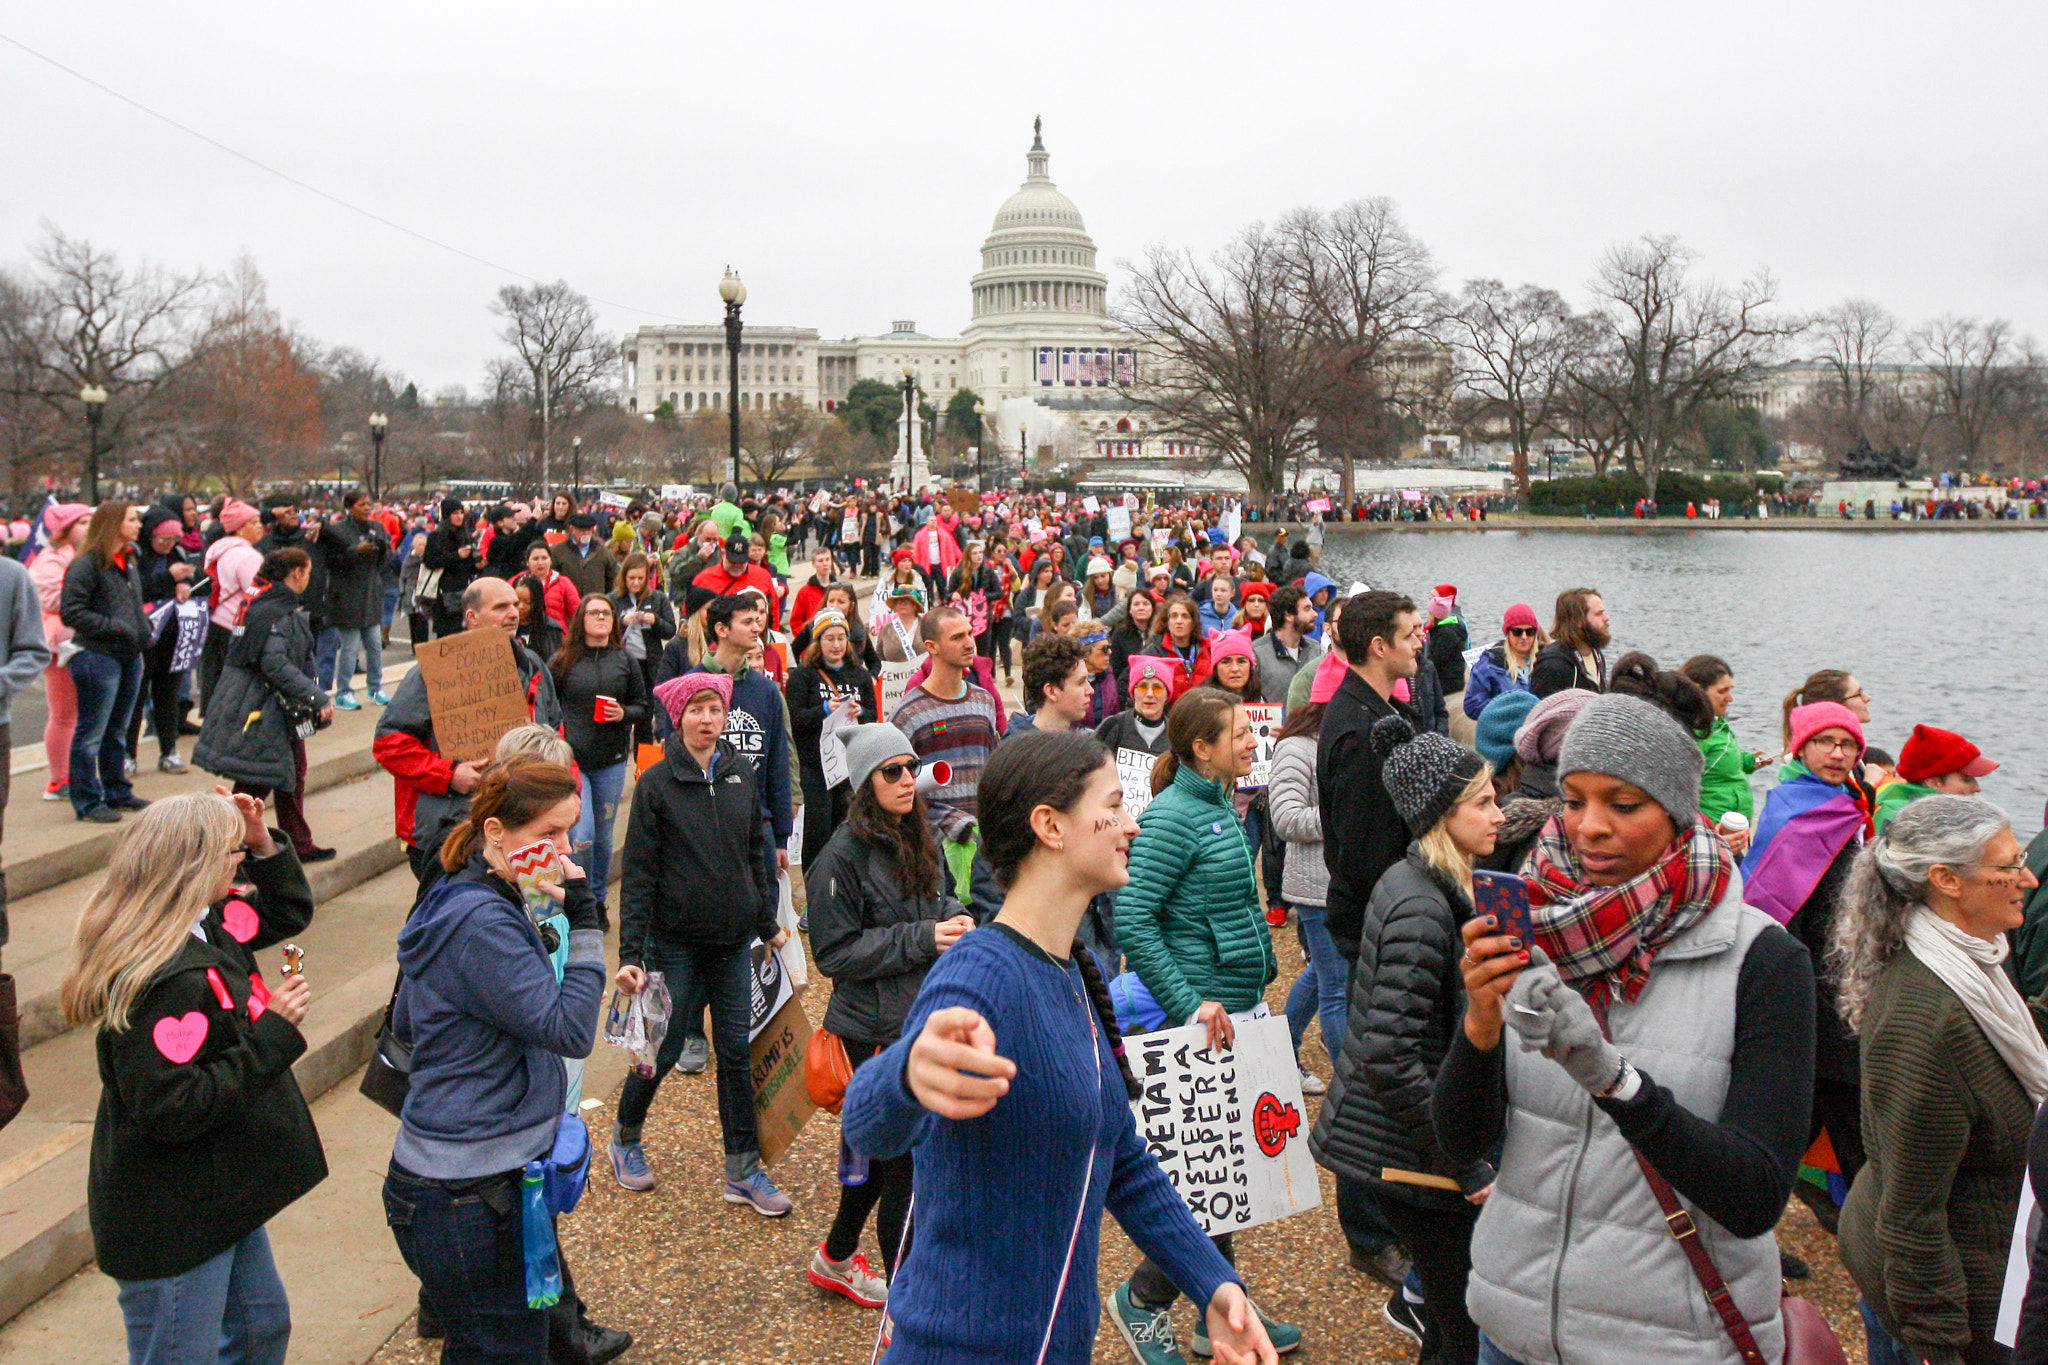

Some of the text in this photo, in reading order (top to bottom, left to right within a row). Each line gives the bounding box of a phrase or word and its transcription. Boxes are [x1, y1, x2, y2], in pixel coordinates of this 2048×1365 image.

[174, 619, 193, 671] LAWS
[440, 641, 469, 658] Dear
[456, 643, 506, 671] DONALD
[460, 670, 482, 689] NO
[485, 660, 517, 681] GOOD
[882, 667, 920, 681] CENTUR
[488, 679, 522, 698] NEVER
[439, 705, 498, 732] TRY MY
[823, 719, 843, 787] FUCK
[1117, 749, 1157, 771] BITC
[1243, 772, 1268, 787] MATT
[1126, 787, 1151, 803] SHI
[1093, 816, 1121, 834] NAS
[752, 1039, 781, 1088] RUMP
[1192, 1047, 1229, 1186] ESPERA
